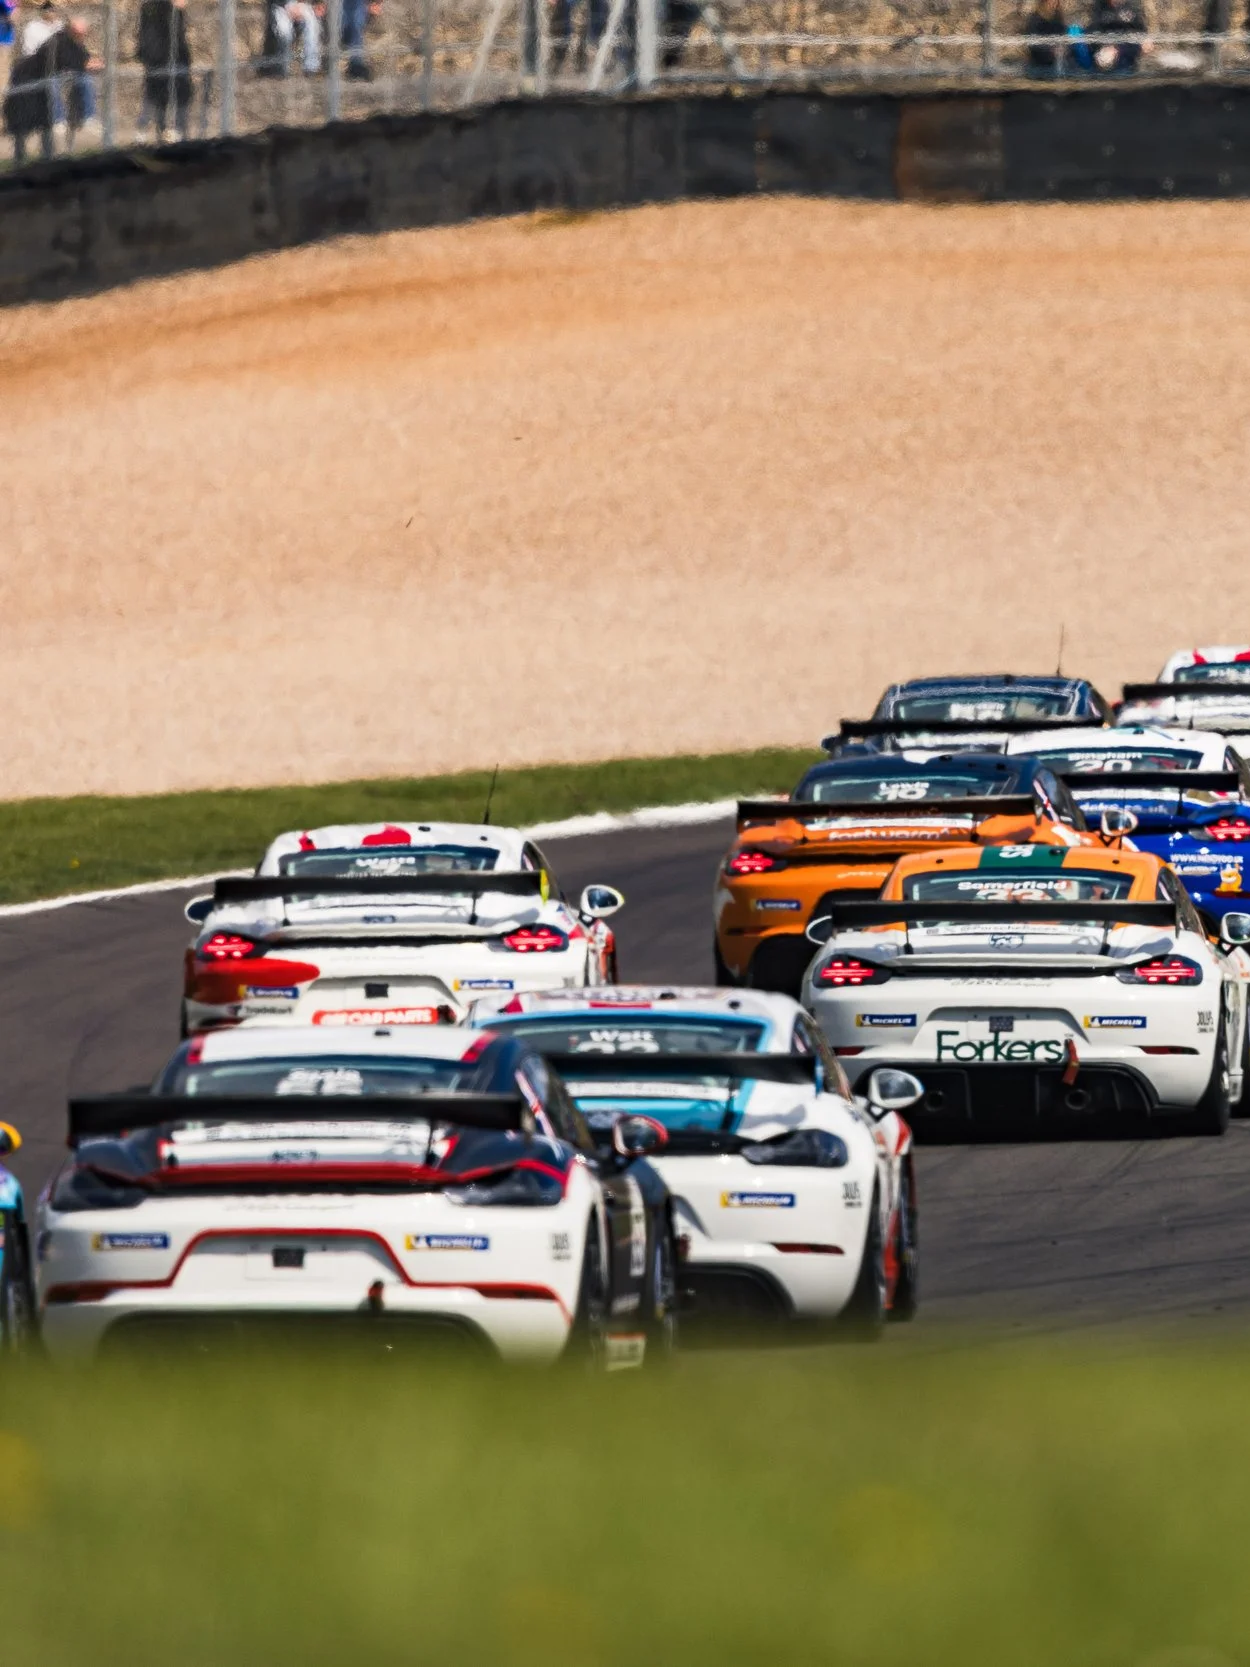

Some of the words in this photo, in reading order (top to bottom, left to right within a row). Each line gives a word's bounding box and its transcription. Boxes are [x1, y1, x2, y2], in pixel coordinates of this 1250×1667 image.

[957, 881, 1068, 891] Somerfield
[384, 1008, 432, 1023] PARTS
[936, 1030, 1064, 1064] Forkers
